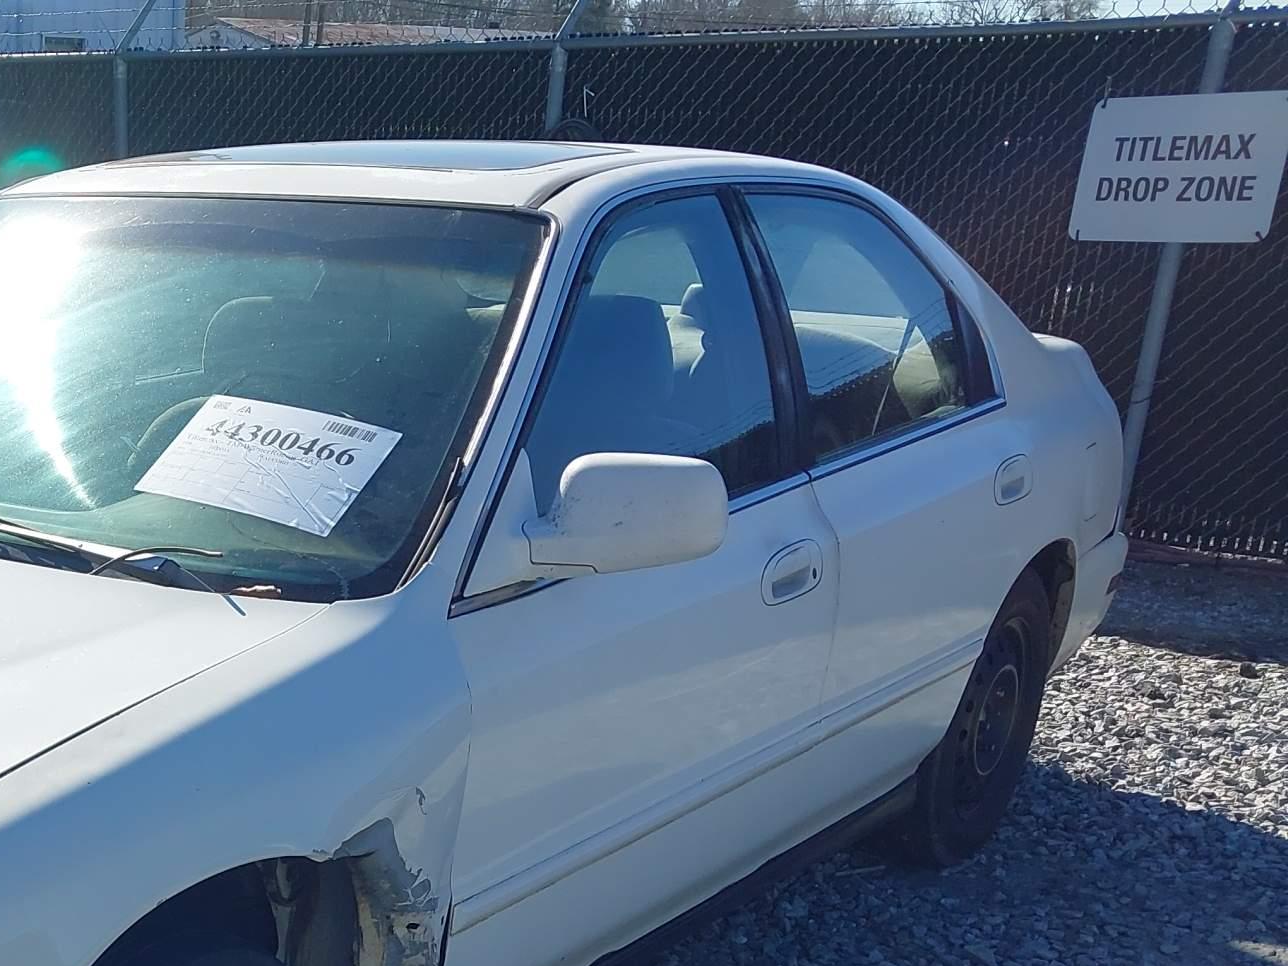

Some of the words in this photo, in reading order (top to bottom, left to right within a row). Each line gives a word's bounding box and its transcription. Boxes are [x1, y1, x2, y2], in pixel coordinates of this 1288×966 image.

[1115, 133, 1257, 162] TITLEMAX
[1095, 176, 1170, 202] DROP
[1175, 175, 1257, 202] ZONE
[205, 418, 362, 467] 44300466
